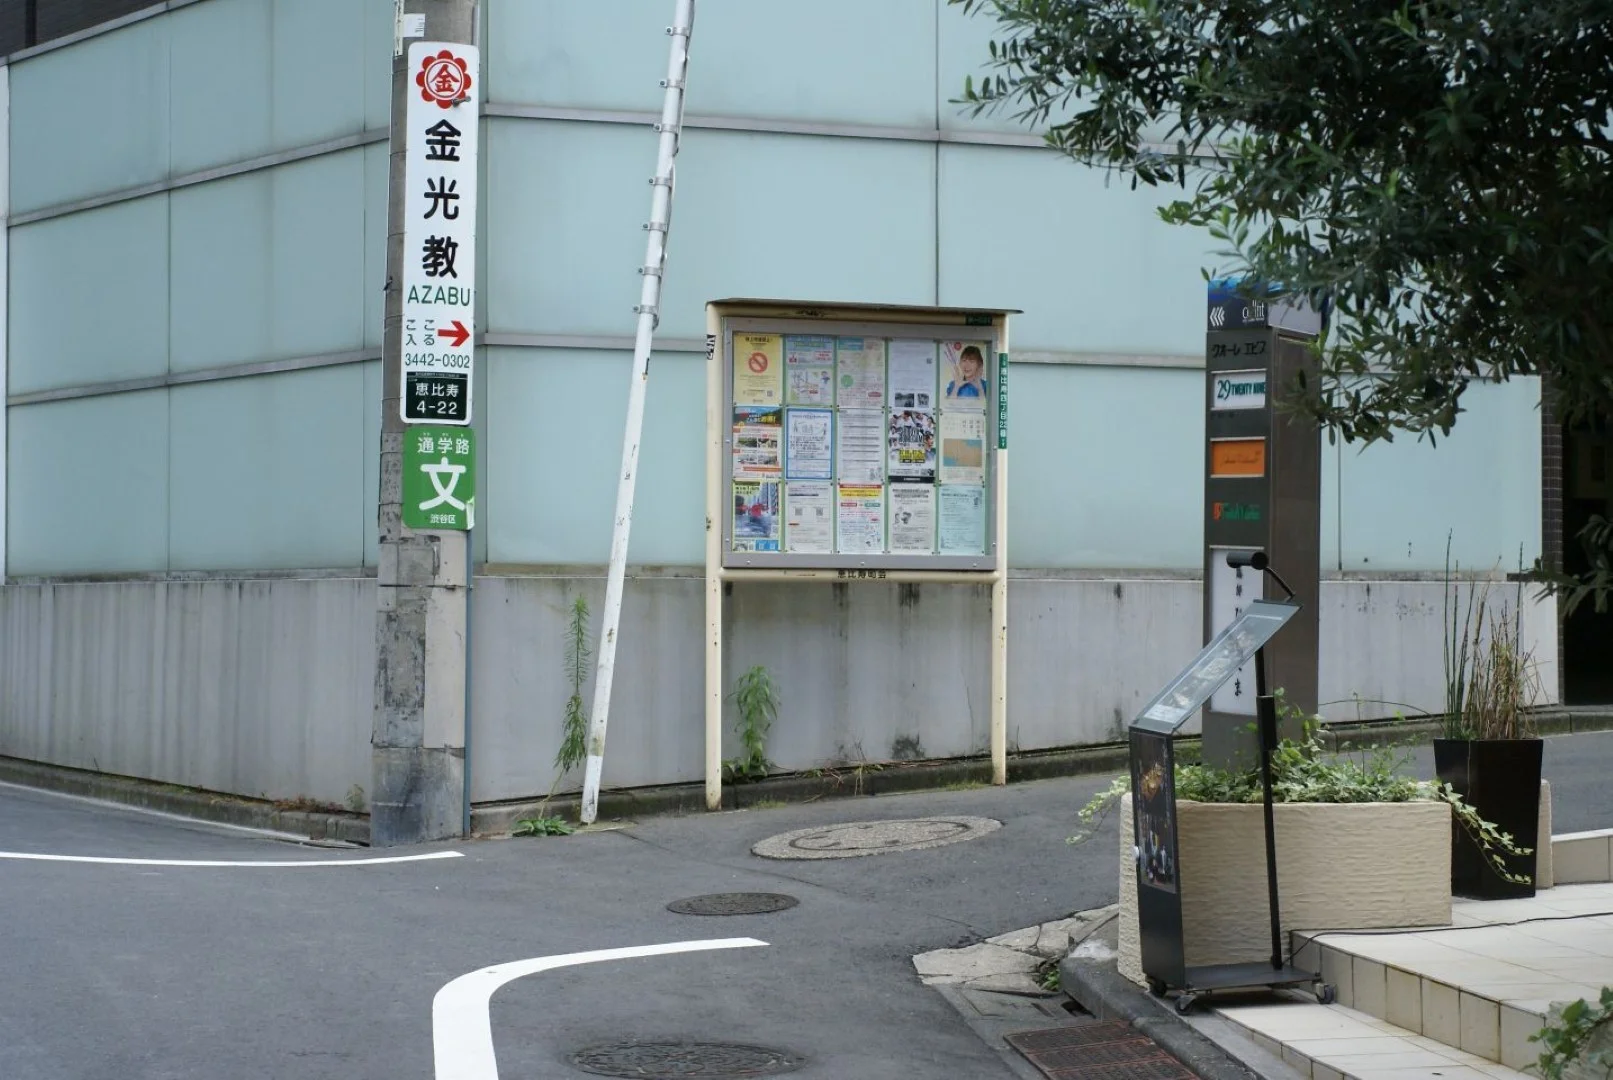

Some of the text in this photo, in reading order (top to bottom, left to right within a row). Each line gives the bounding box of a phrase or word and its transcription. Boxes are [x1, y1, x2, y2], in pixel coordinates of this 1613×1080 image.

[422, 119, 462, 280] 金光教
[407, 285, 471, 306] AZABU
[404, 352, 471, 369] 3442-0302
[415, 382, 460, 398] 恵比寿
[1217, 379, 1231, 401] 29
[416, 400, 458, 415] 4-22
[417, 436, 470, 455] 通学路
[429, 514, 456, 524] 渋谷区
